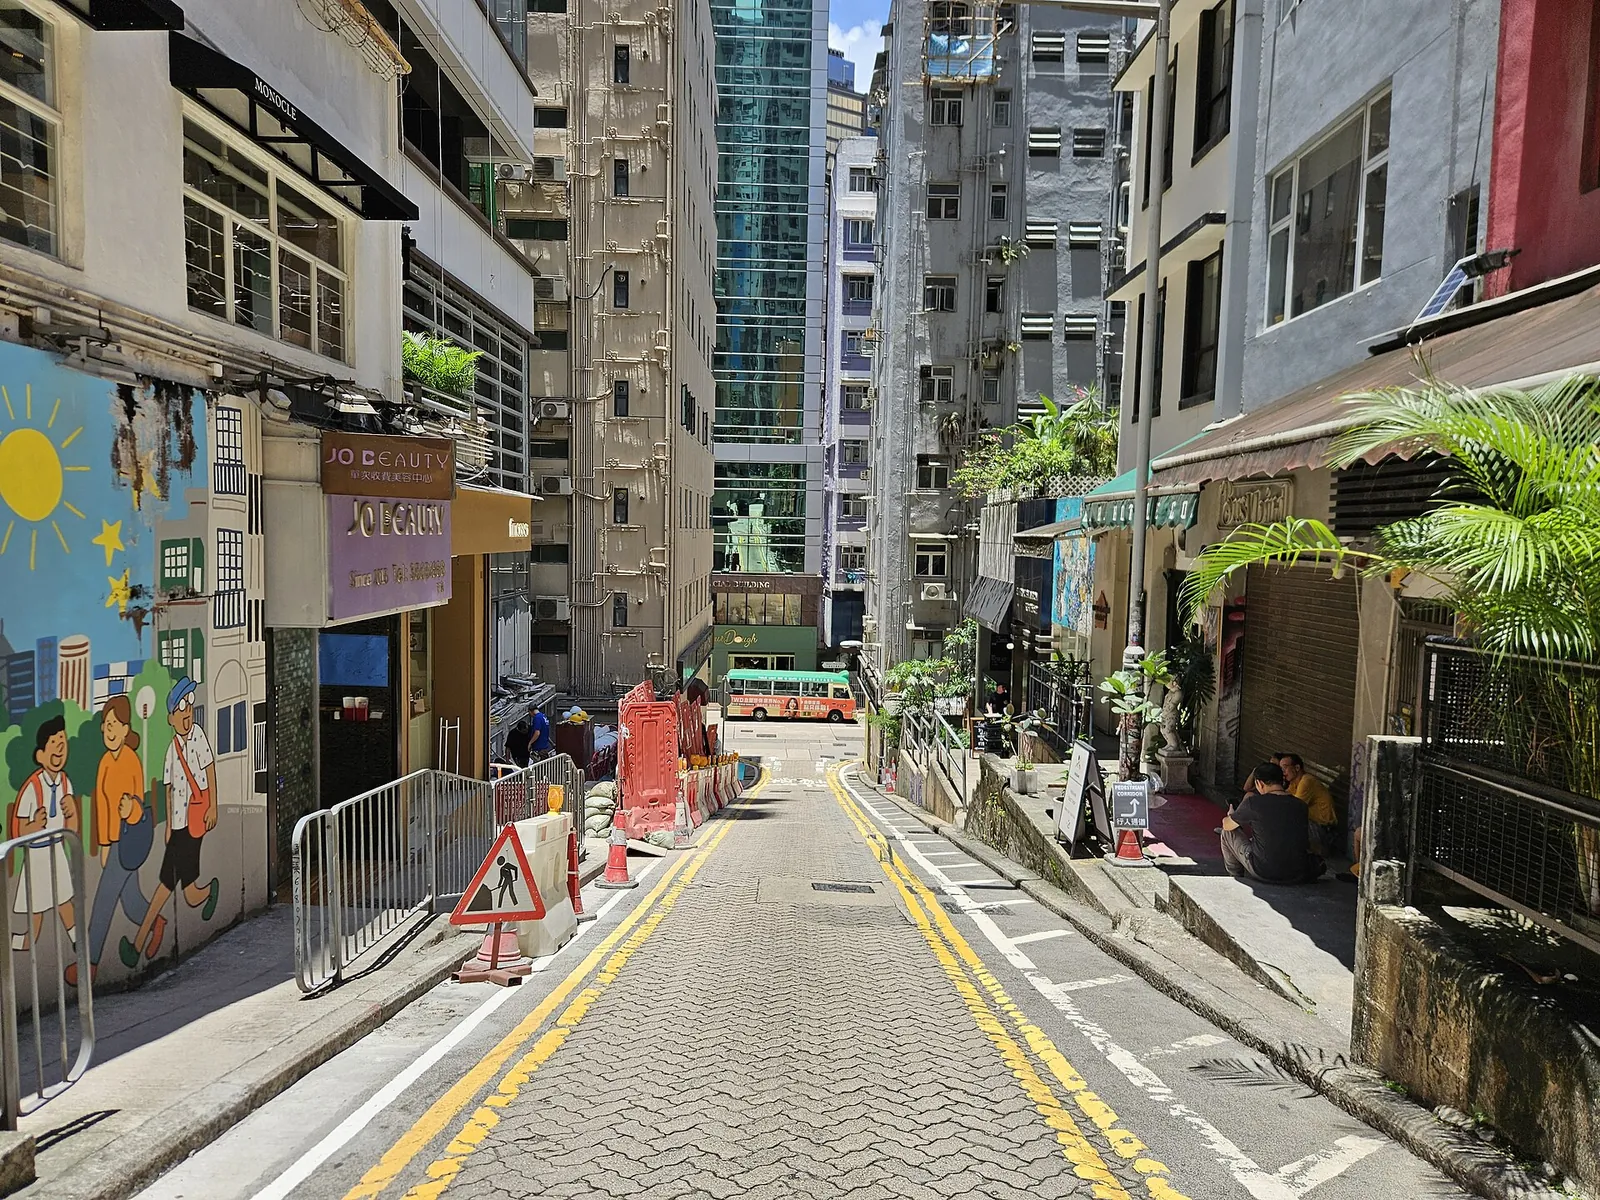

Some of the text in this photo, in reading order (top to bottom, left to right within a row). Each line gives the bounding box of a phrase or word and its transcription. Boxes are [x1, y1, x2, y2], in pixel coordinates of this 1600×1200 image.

[254, 77, 297, 121] MONOCLE
[325, 448, 449, 469] JO BEAUTY
[347, 498, 445, 538] JO BEAUTY
[349, 570, 372, 588] Since
[711, 580, 770, 589] CIAL BUILDING
